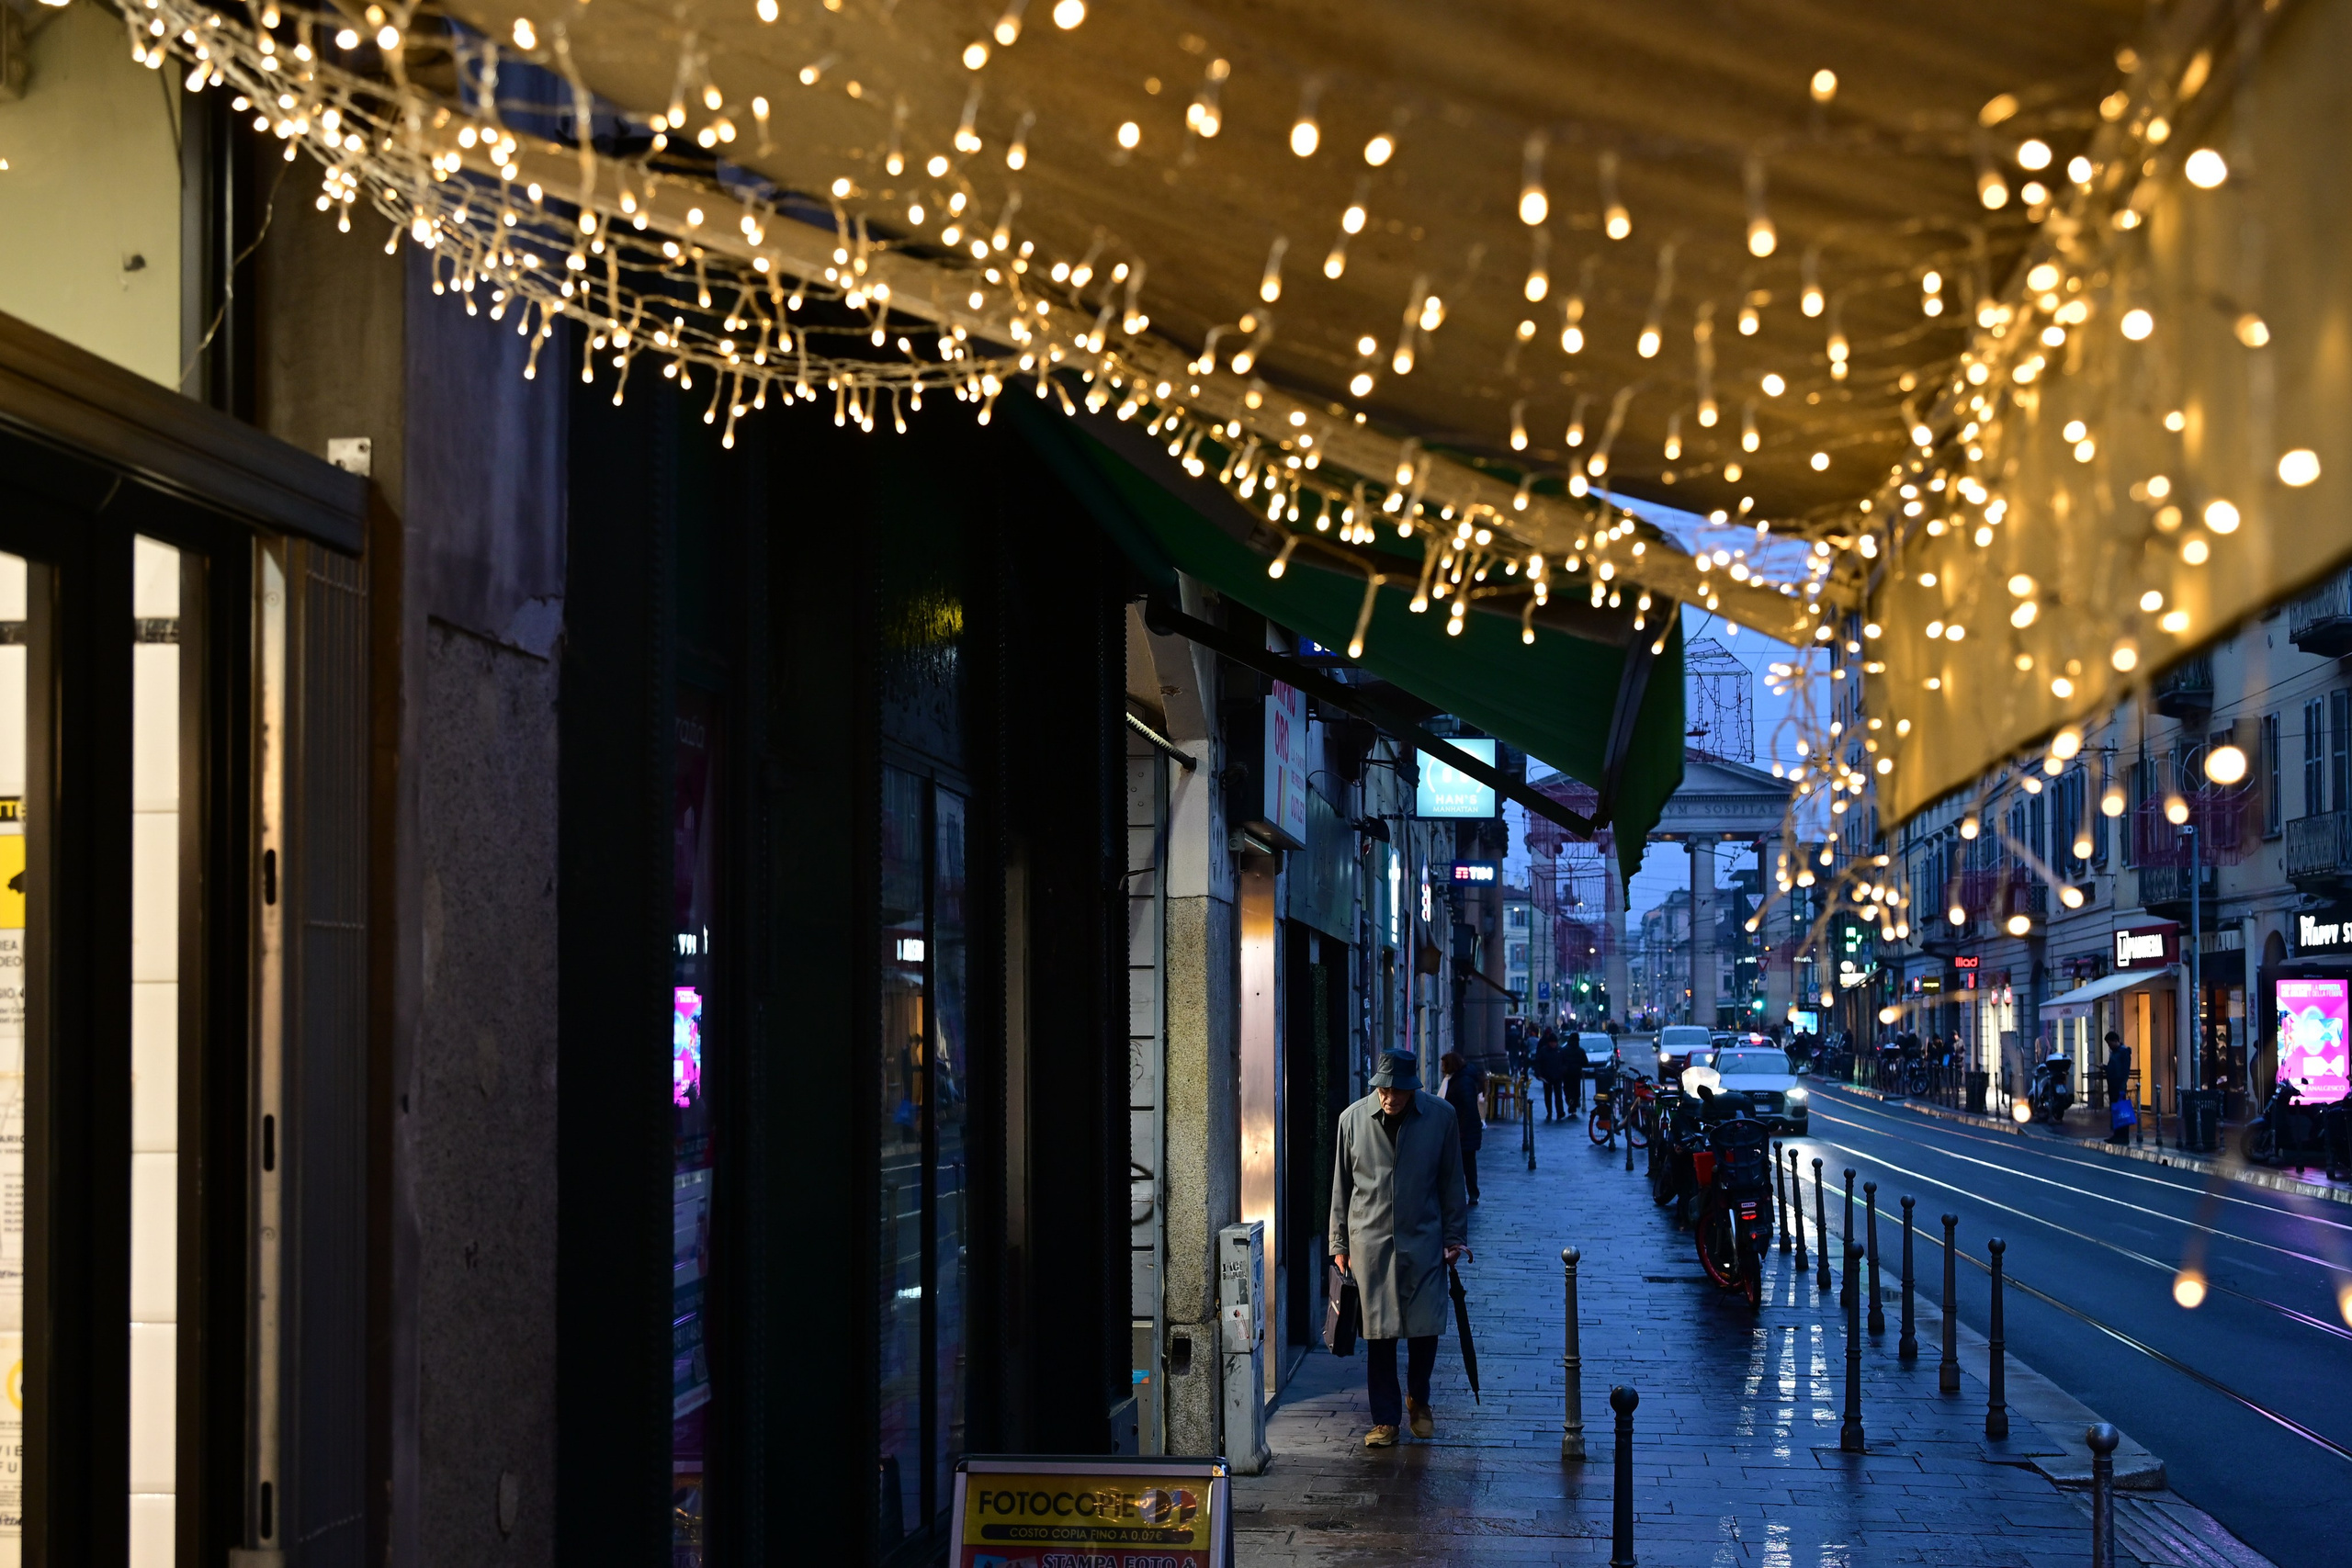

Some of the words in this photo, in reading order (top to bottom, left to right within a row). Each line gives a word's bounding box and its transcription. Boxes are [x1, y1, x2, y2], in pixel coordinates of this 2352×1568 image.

[1274, 709, 1289, 764] ORO
[1435, 794, 1477, 805] HAN'S
[1704, 805, 1777, 814] SOSPITAE
[1469, 866, 1494, 881] TIM
[2300, 915, 2339, 947] HAPPY
[978, 1490, 1135, 1517] FOTOCOPIE
[1010, 1527, 1048, 1539] COSTO
[1051, 1528, 1088, 1540] COPIA
[1091, 1529, 1116, 1540] FINO
[1119, 1529, 1128, 1541] A
[1130, 1530, 1163, 1543] 0,07€
[1043, 1553, 1117, 1568] STAMPA
[1124, 1556, 1177, 1568] FOTO
